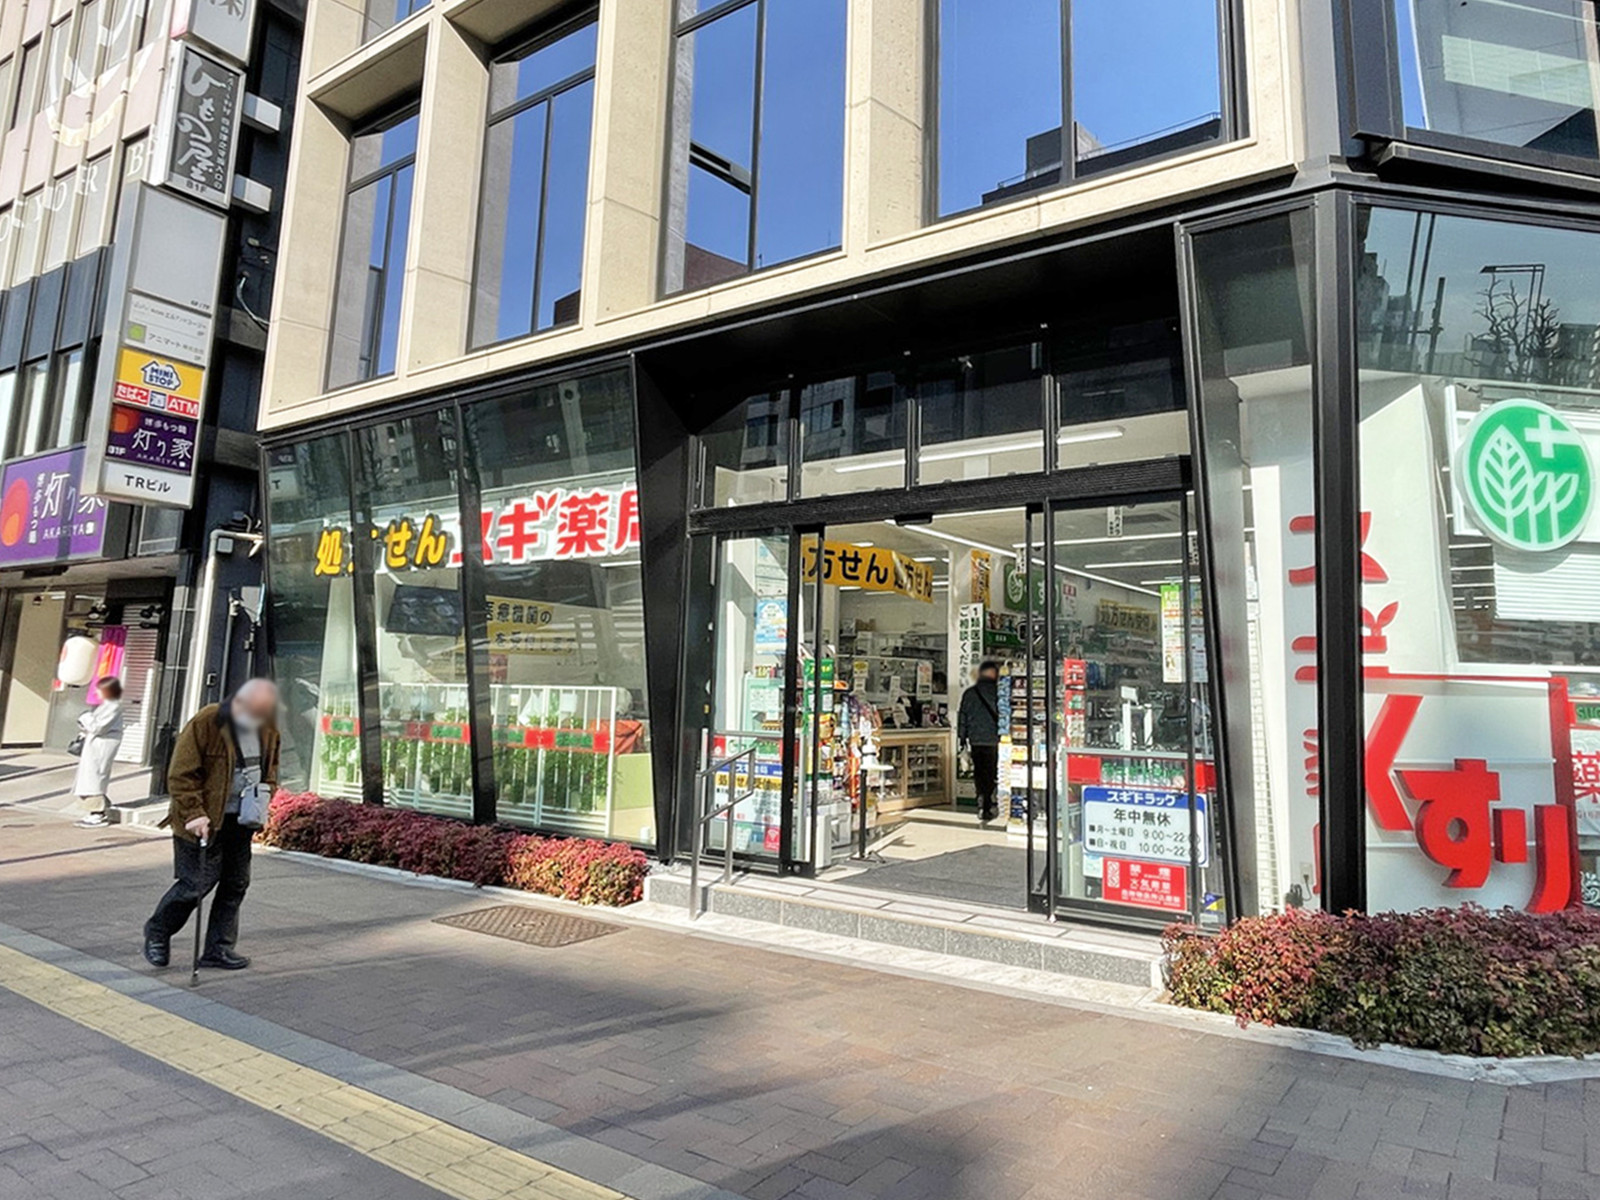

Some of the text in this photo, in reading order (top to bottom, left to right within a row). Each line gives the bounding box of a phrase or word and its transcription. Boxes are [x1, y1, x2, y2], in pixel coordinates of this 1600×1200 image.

[149, 374, 173, 386] STOP
[150, 366, 174, 379] MINI
[115, 384, 148, 403] たばこ
[168, 398, 199, 416] ATM
[131, 428, 193, 460] 灯り家
[124, 474, 171, 492] TRビル
[314, 513, 447, 577] 処せん
[802, 548, 889, 584] 方せん
[1106, 790, 1177, 807] スギドラッグ
[1365, 693, 1572, 915] くすり
[1113, 807, 1172, 828] 年中無休
